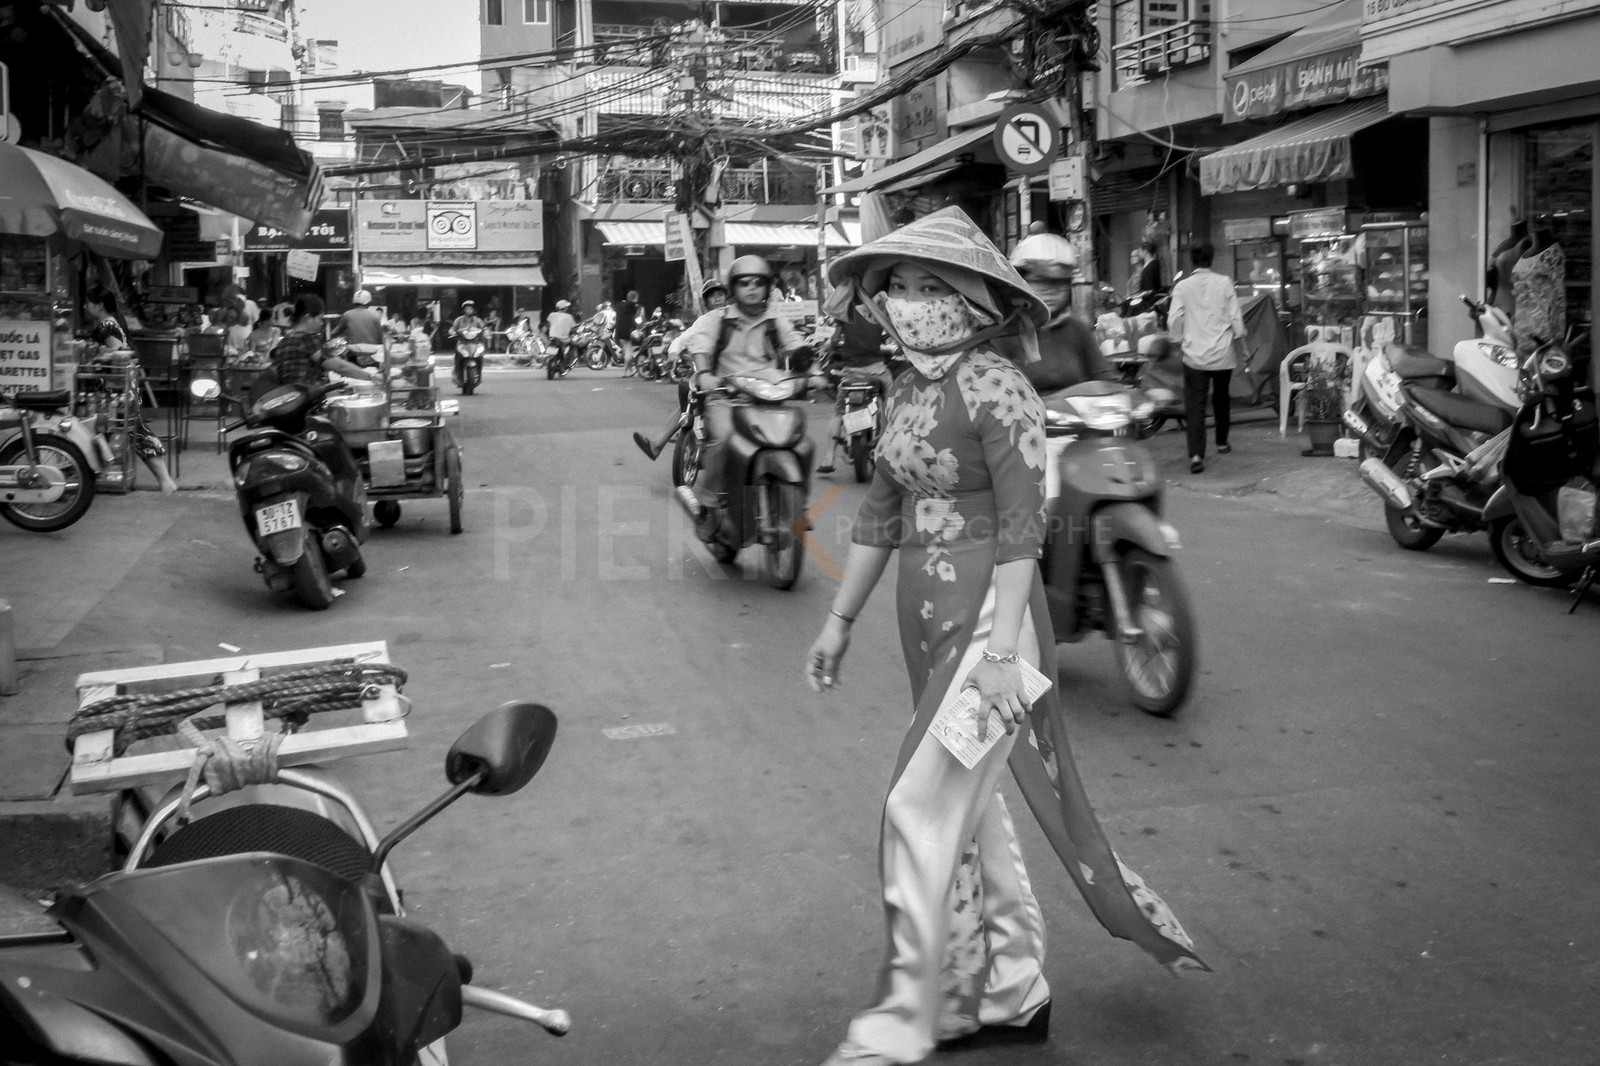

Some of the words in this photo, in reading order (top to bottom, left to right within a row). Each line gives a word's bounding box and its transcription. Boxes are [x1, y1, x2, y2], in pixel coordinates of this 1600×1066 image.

[310, 223, 335, 236] TÔI
[26, 331, 40, 344] LÁ
[17, 350, 40, 361] GAS
